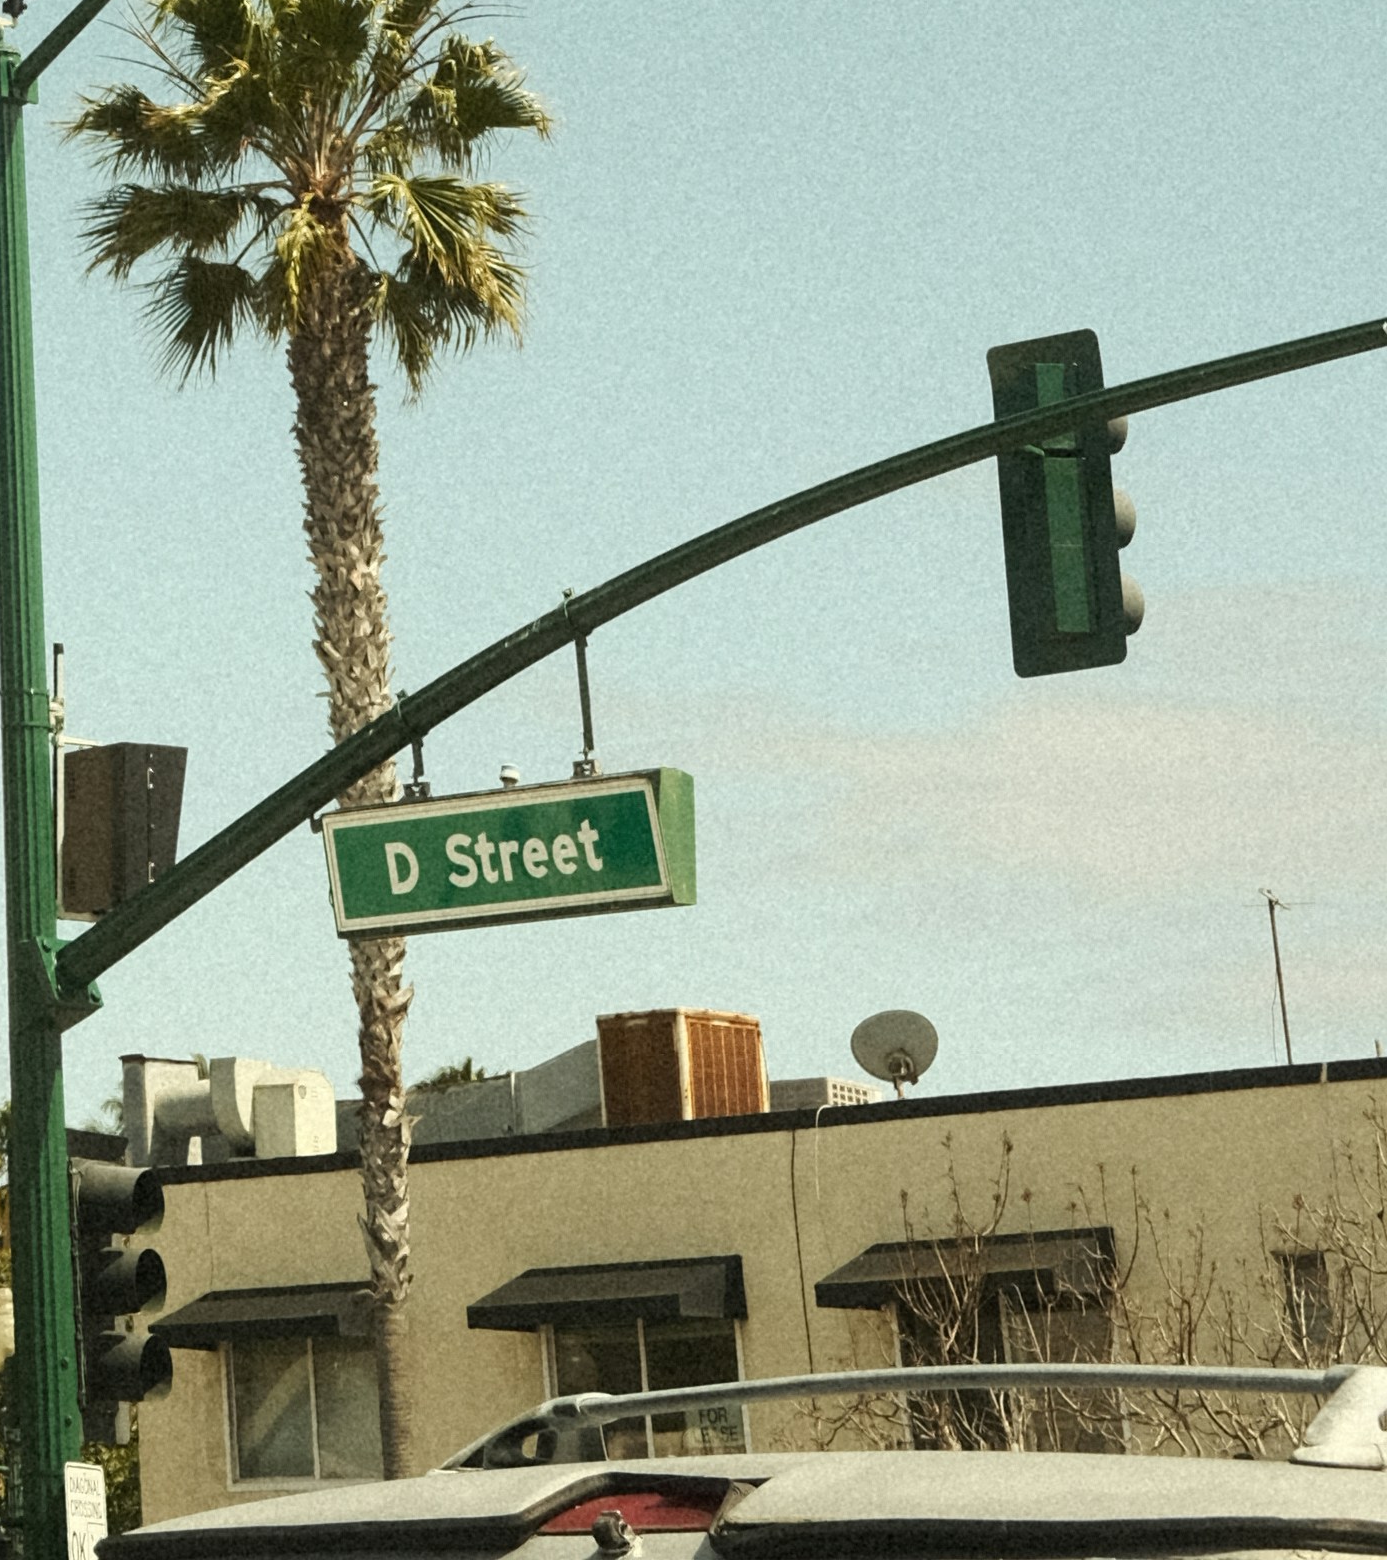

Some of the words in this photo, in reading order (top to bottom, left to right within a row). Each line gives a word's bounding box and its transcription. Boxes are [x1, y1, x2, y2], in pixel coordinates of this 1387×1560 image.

[384, 841, 419, 895] D
[445, 819, 603, 888] Street
[698, 1407, 728, 1425] FOR
